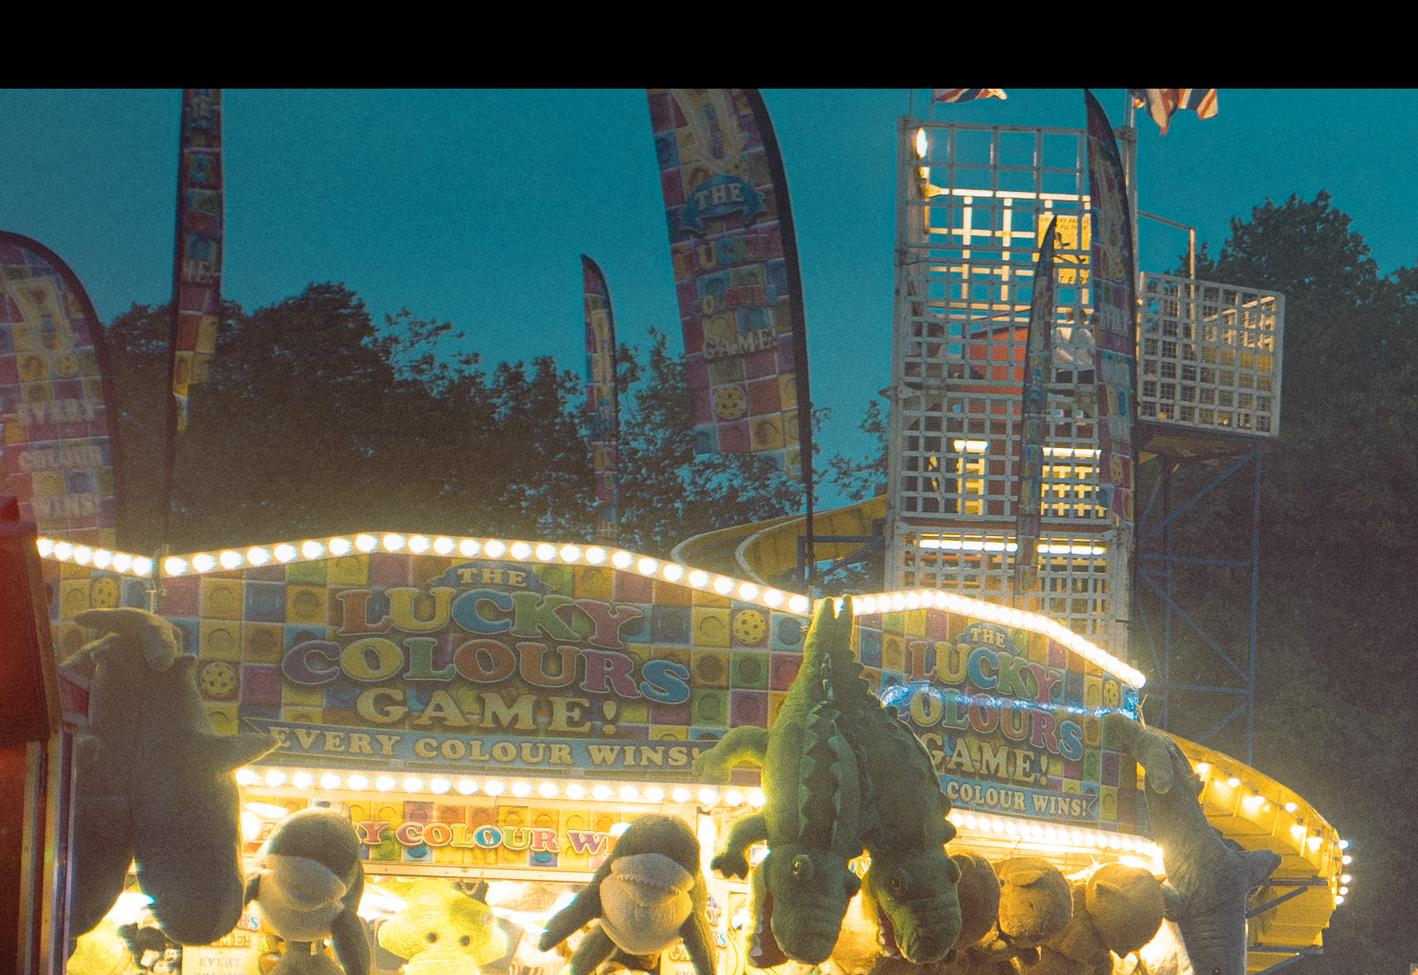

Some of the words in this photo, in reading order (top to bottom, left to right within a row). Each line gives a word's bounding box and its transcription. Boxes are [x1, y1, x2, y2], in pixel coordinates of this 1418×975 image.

[694, 182, 744, 210] THE
[702, 327, 780, 361] GAME!
[16, 398, 96, 427] EVERY
[18, 446, 104, 472] COLOUR
[456, 567, 529, 588] THE
[335, 586, 643, 649] LUCKY
[970, 627, 1006, 647] THE
[281, 636, 691, 704] COLOURS
[908, 640, 1061, 702] LUCKY
[355, 687, 620, 735] GAME!
[897, 686, 1084, 761] OLOURS
[271, 727, 402, 758] EVERY
[414, 736, 574, 766] COLOUR
[587, 744, 700, 768] WINS!
[919, 732, 1049, 786] GAME!
[946, 780, 1026, 811] COLOUR
[1032, 793, 1088, 817] WINS!
[396, 821, 560, 853] COLOUR
